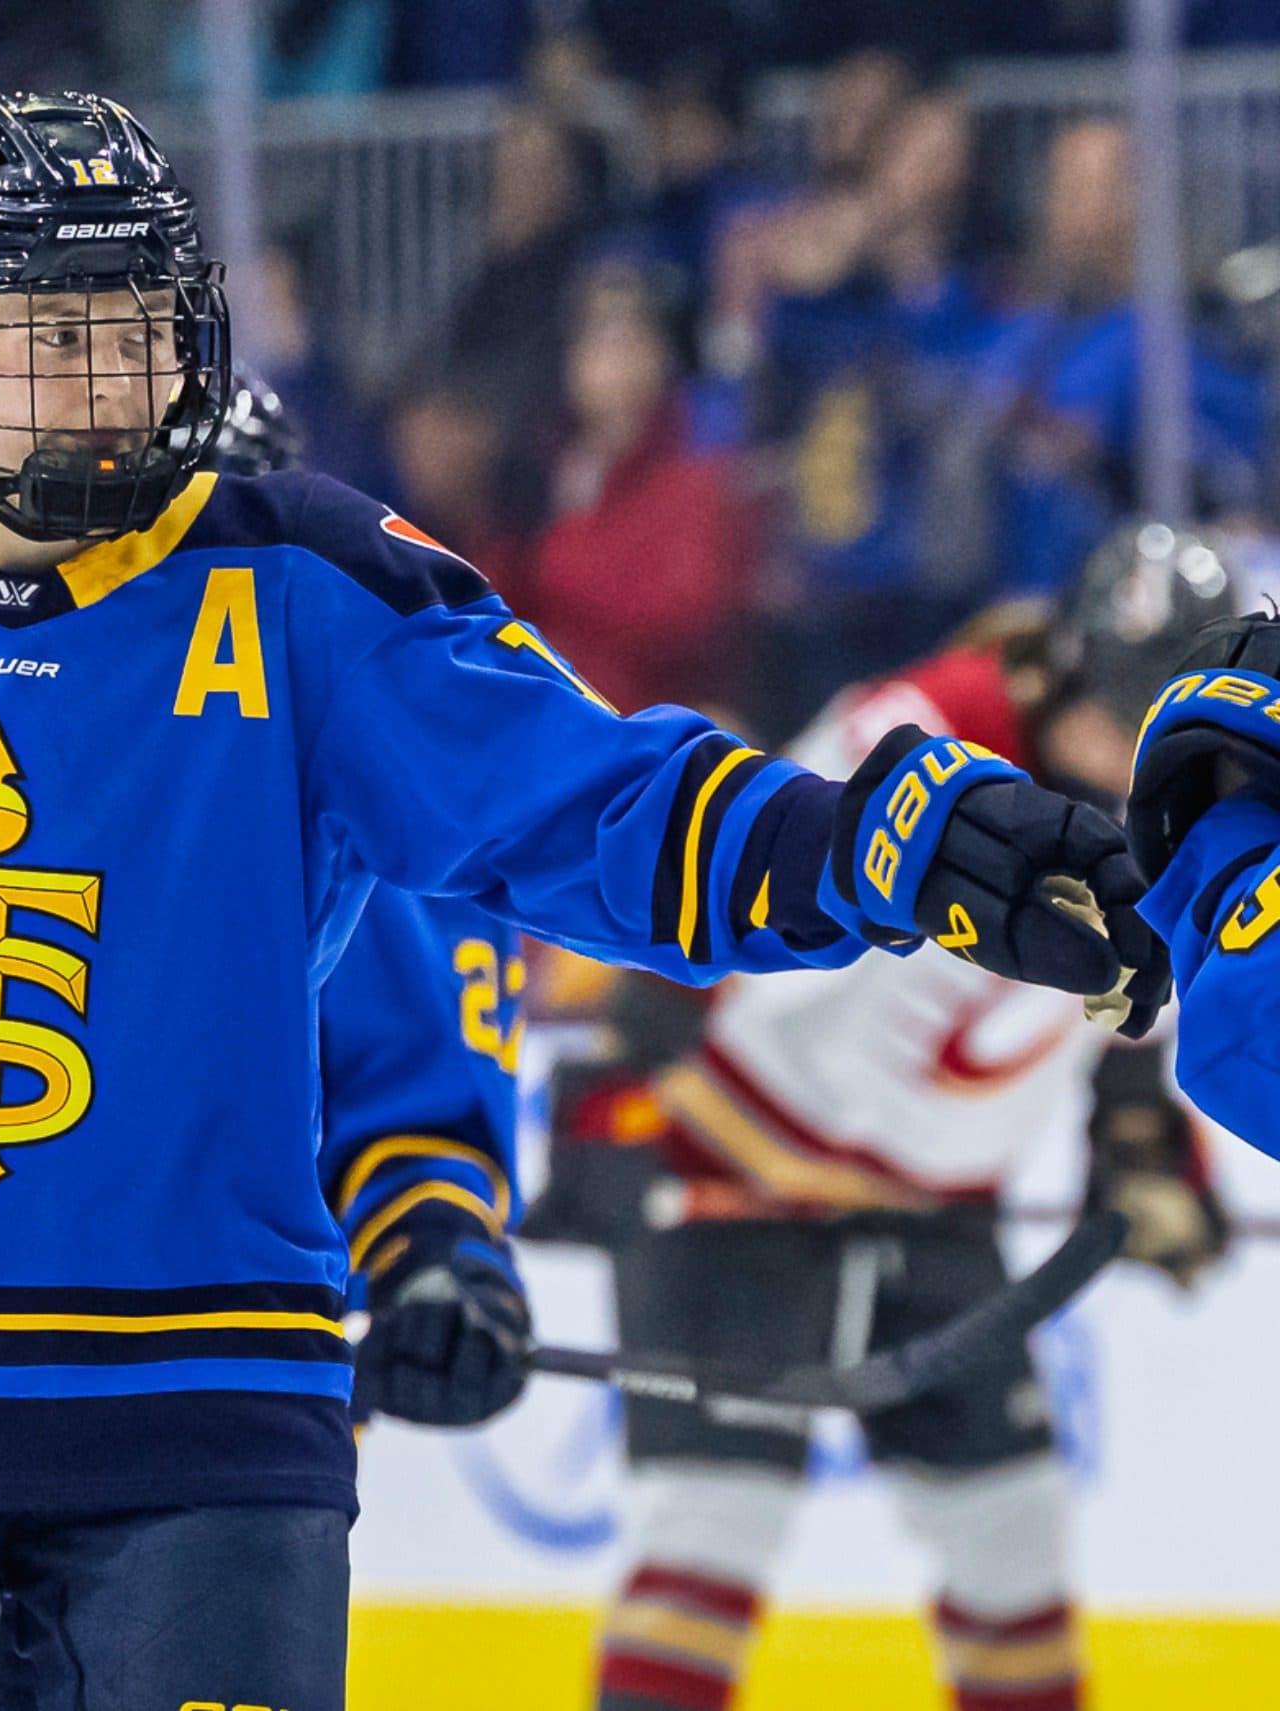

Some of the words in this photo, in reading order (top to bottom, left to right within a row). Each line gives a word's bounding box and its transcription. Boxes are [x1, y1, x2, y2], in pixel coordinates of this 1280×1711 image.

[70, 158, 119, 187] 12
[56, 222, 149, 240] BAUER
[173, 567, 270, 719] A
